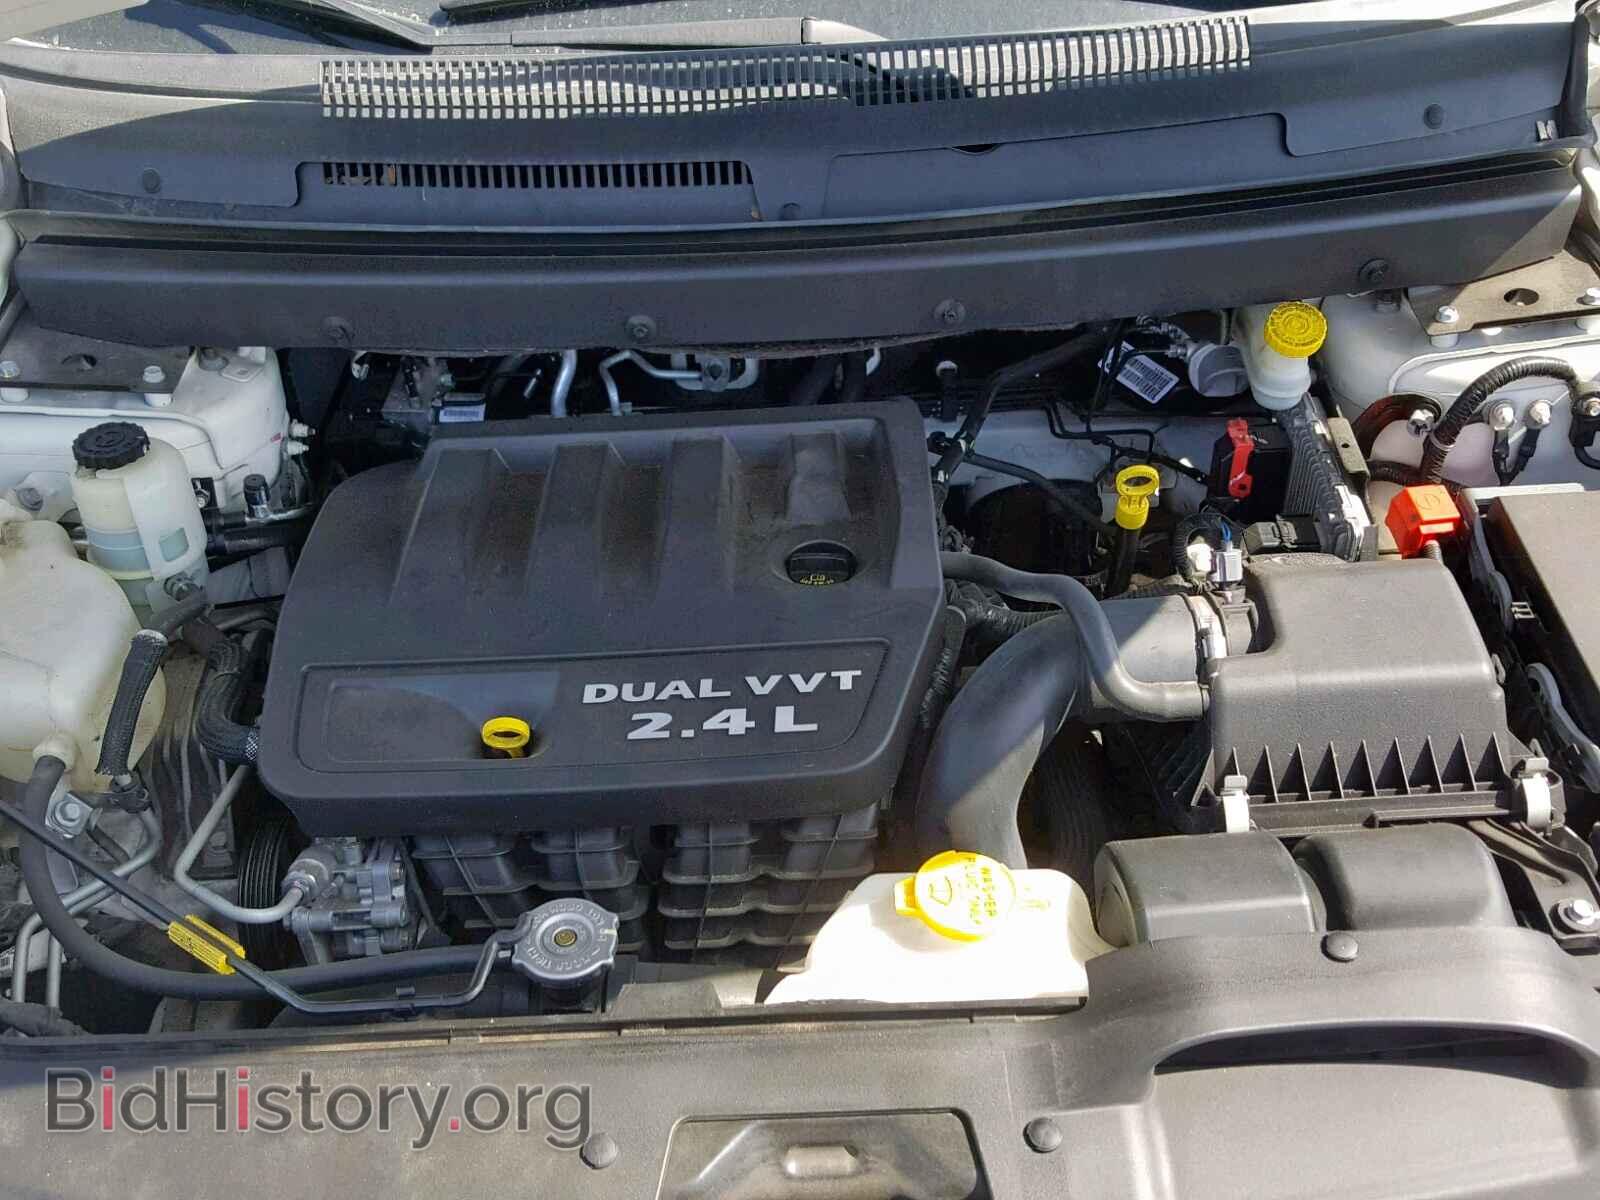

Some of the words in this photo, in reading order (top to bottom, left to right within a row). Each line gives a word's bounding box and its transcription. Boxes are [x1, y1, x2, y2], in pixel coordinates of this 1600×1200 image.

[582, 679, 731, 704] DUAL
[744, 670, 862, 696] VVT
[981, 866, 998, 917] WASHER
